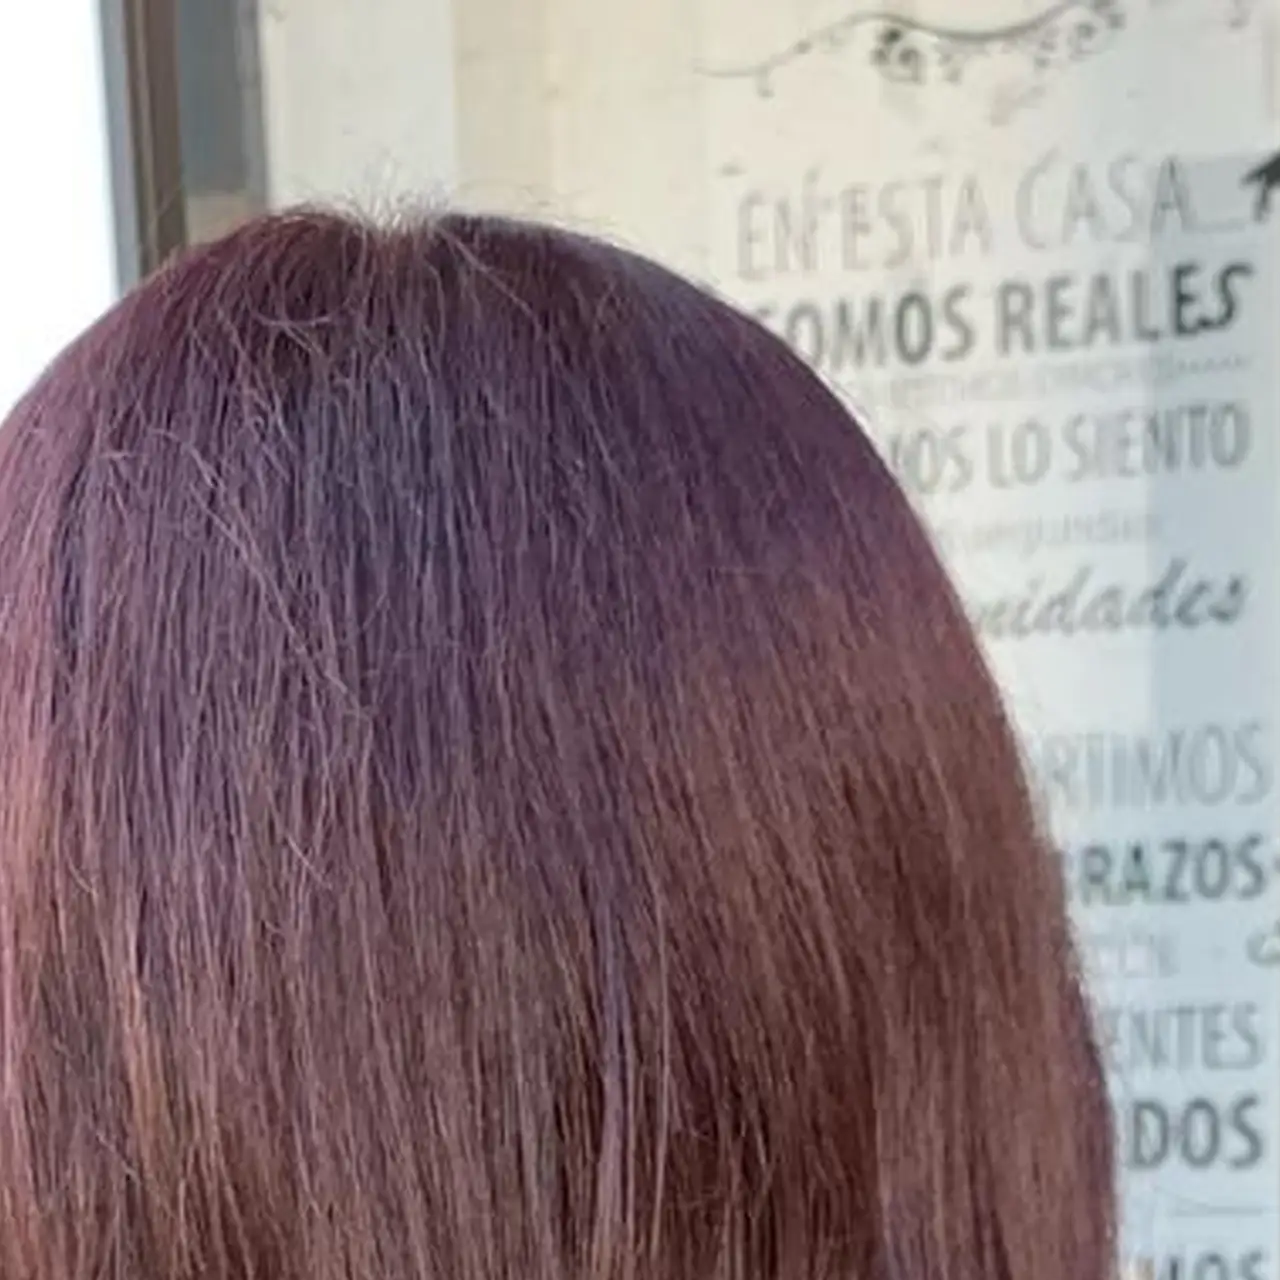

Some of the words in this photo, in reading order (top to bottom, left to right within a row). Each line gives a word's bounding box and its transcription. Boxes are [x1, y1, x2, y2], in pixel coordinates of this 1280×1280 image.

[837, 173, 993, 272] ESTA
[1015, 148, 1198, 250] CASA
[754, 283, 977, 371] OMOS
[994, 262, 1255, 358] REALES
[985, 419, 1053, 490] LO
[1062, 400, 1253, 482] SIENTO
[1128, 1092, 1263, 1171] DOS
